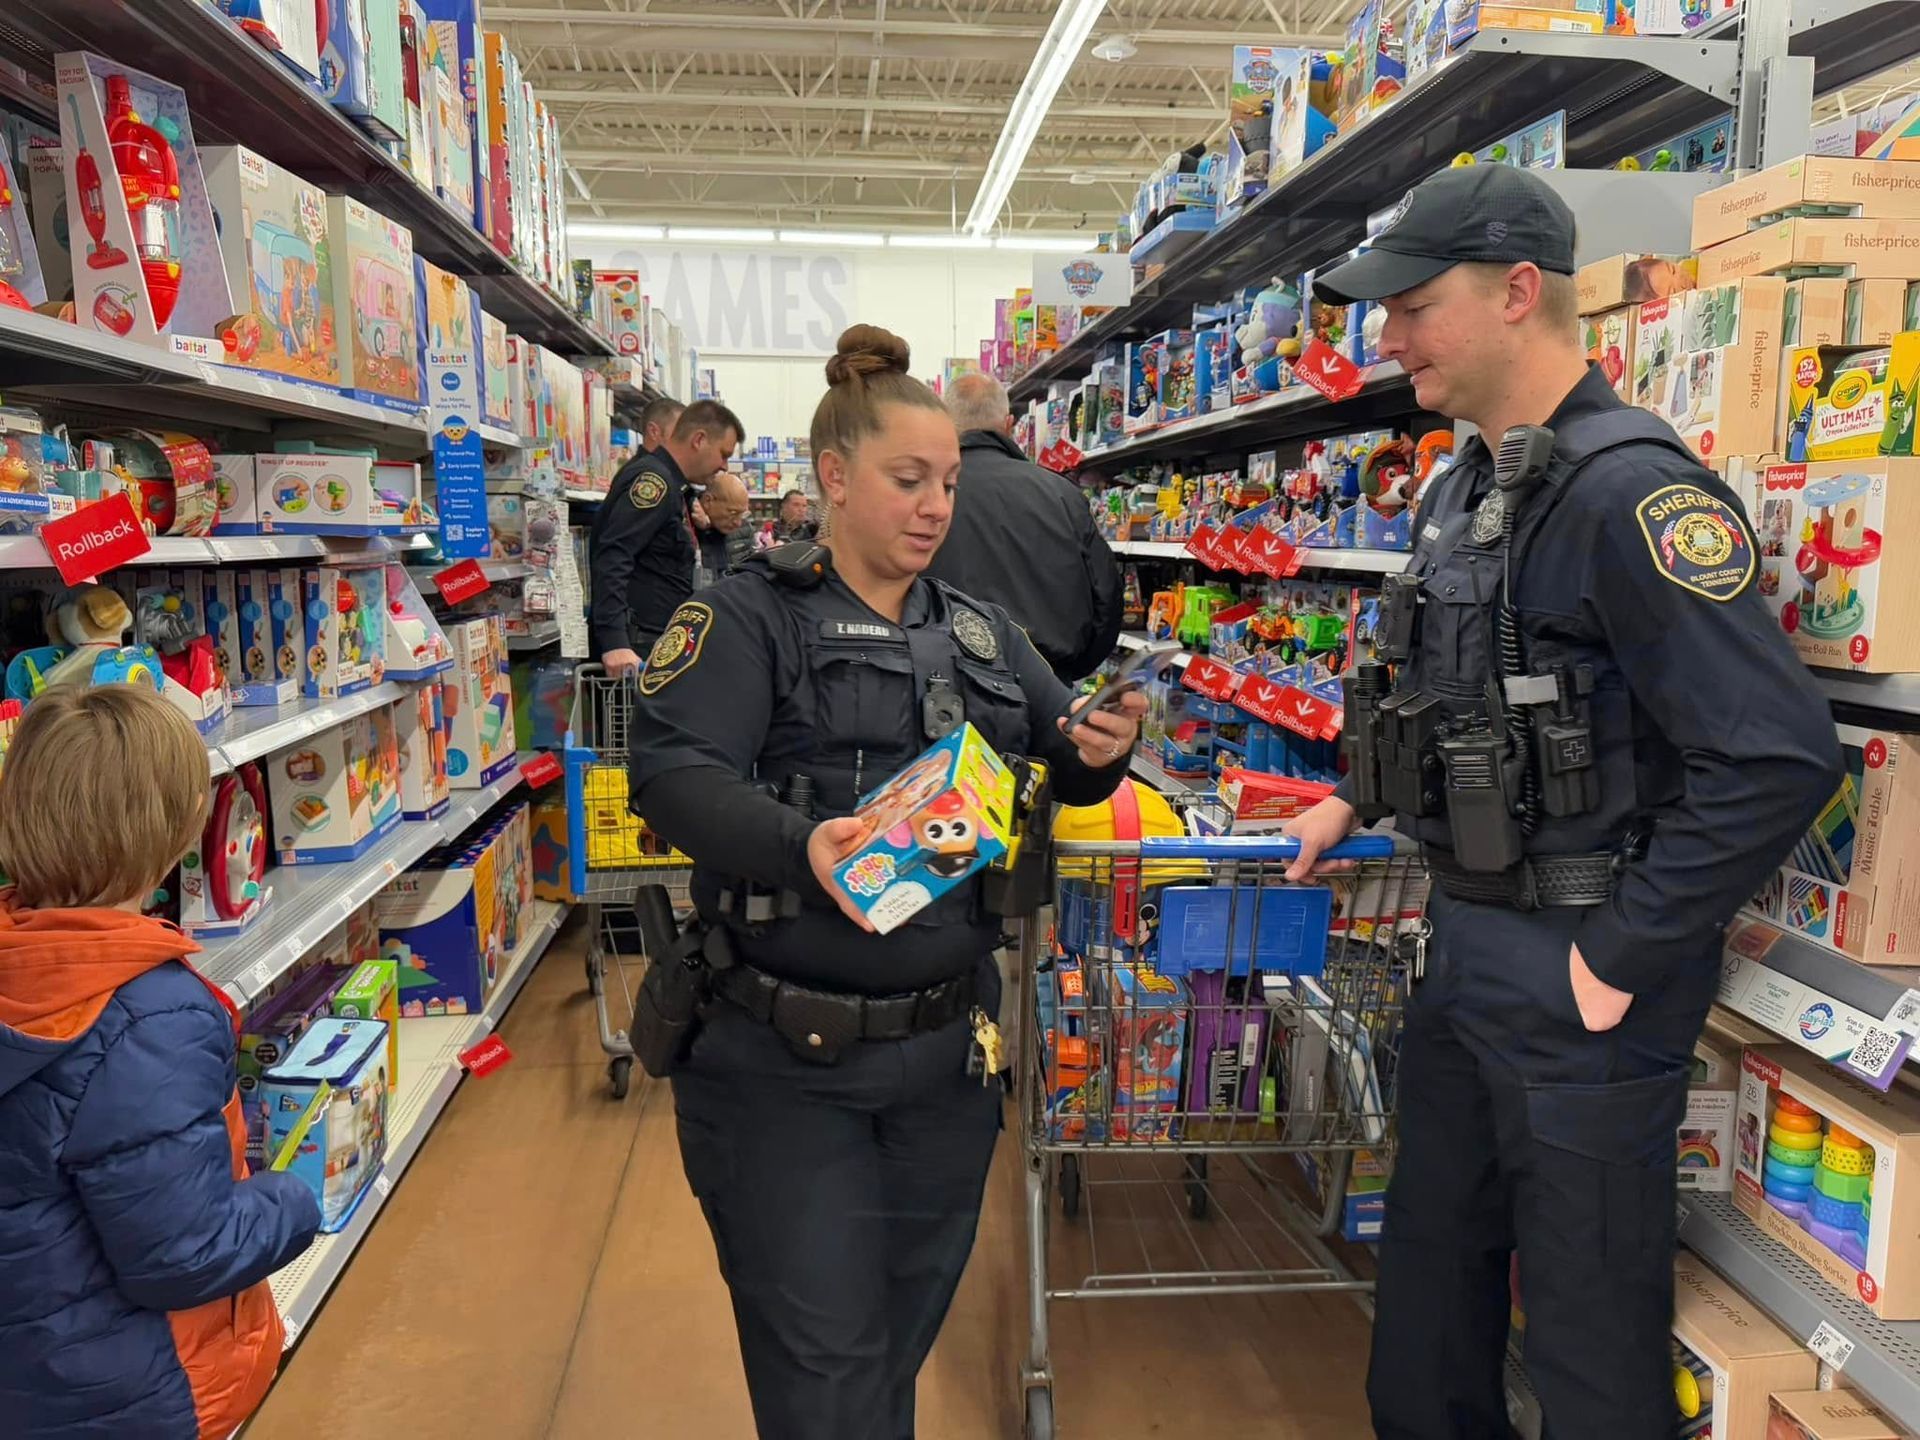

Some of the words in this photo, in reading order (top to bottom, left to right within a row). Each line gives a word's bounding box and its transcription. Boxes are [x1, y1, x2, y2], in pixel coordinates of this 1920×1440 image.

[242, 152, 264, 175] battat
[1720, 190, 1768, 215] fisher-price
[1845, 233, 1920, 251] fisher-price
[1720, 251, 1761, 274] fisher-price
[176, 338, 207, 354] battat
[431, 353, 467, 364] battat
[1750, 330, 1769, 409] fisher-price
[1800, 359, 1814, 370] 152
[1298, 364, 1338, 398] Rollback
[1837, 383, 1861, 397] Crayola
[1821, 406, 1875, 429] ULTIMATE
[1702, 437, 1712, 448] 3+
[1768, 470, 1805, 483] fisher-price
[52, 498, 73, 512] battat
[1648, 493, 1722, 521] SHERIFF
[57, 519, 134, 561] Rollback
[1187, 542, 1218, 569] Rollback
[1215, 544, 1248, 573] Rollback
[1242, 547, 1277, 575] Rollback
[442, 571, 480, 594] Rollback
[1690, 571, 1717, 582] BLOUNT
[1718, 567, 1744, 577] COUNTY
[1701, 577, 1741, 588] TENNESSEE
[836, 623, 846, 634] T.
[1855, 639, 1862, 651] 9
[1184, 675, 1217, 697] Rollback
[1237, 695, 1271, 718] Rollbac
[1274, 709, 1315, 736] Rollback
[1869, 745, 1880, 762] 2+
[526, 762, 558, 783] Rollback
[1867, 787, 1882, 828] Table
[1853, 833, 1866, 868] Wooden
[1860, 831, 1877, 876] Music
[380, 880, 418, 891] attat
[1799, 1012, 1836, 1030] play-lab
[1845, 1015, 1858, 1027] Scan
[1858, 1022, 1865, 1030] to
[470, 1044, 505, 1069] Rollback
[1744, 1050, 1779, 1081] fisher-price
[1746, 1083, 1757, 1099] 26
[1767, 1216, 1798, 1249] Stacking
[1798, 1239, 1822, 1267] Shape
[1823, 1259, 1848, 1286] Sorter
[1861, 1276, 1873, 1292] 18
[1678, 1270, 1748, 1329] fisher-price
